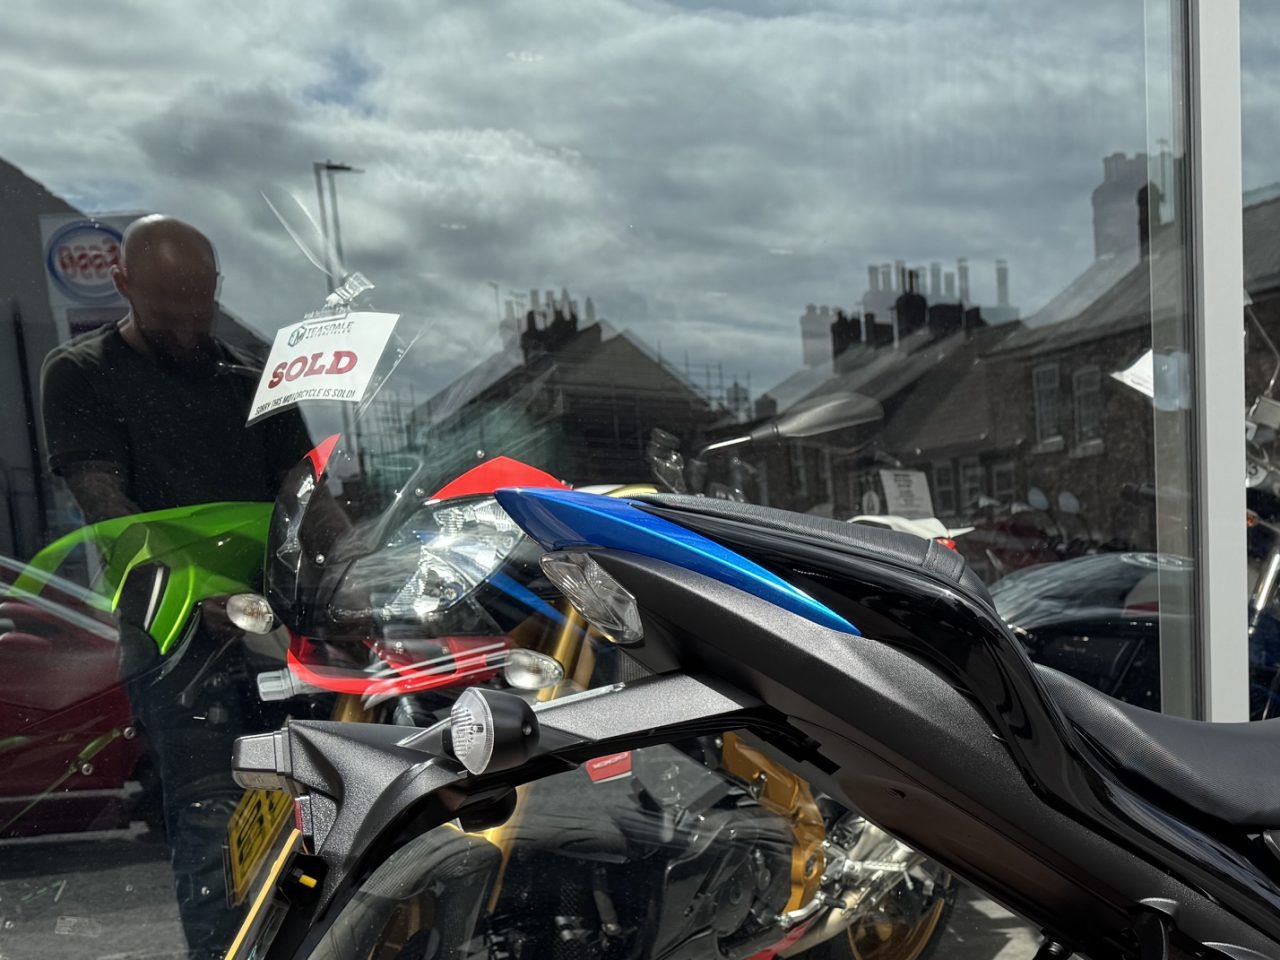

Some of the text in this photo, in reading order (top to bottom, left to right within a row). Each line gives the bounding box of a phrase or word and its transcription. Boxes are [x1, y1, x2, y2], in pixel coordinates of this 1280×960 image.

[306, 321, 355, 336] TEASDALE
[268, 351, 358, 389] SOLD
[283, 388, 321, 404] MOTORCYCLE
[322, 388, 332, 397] IS
